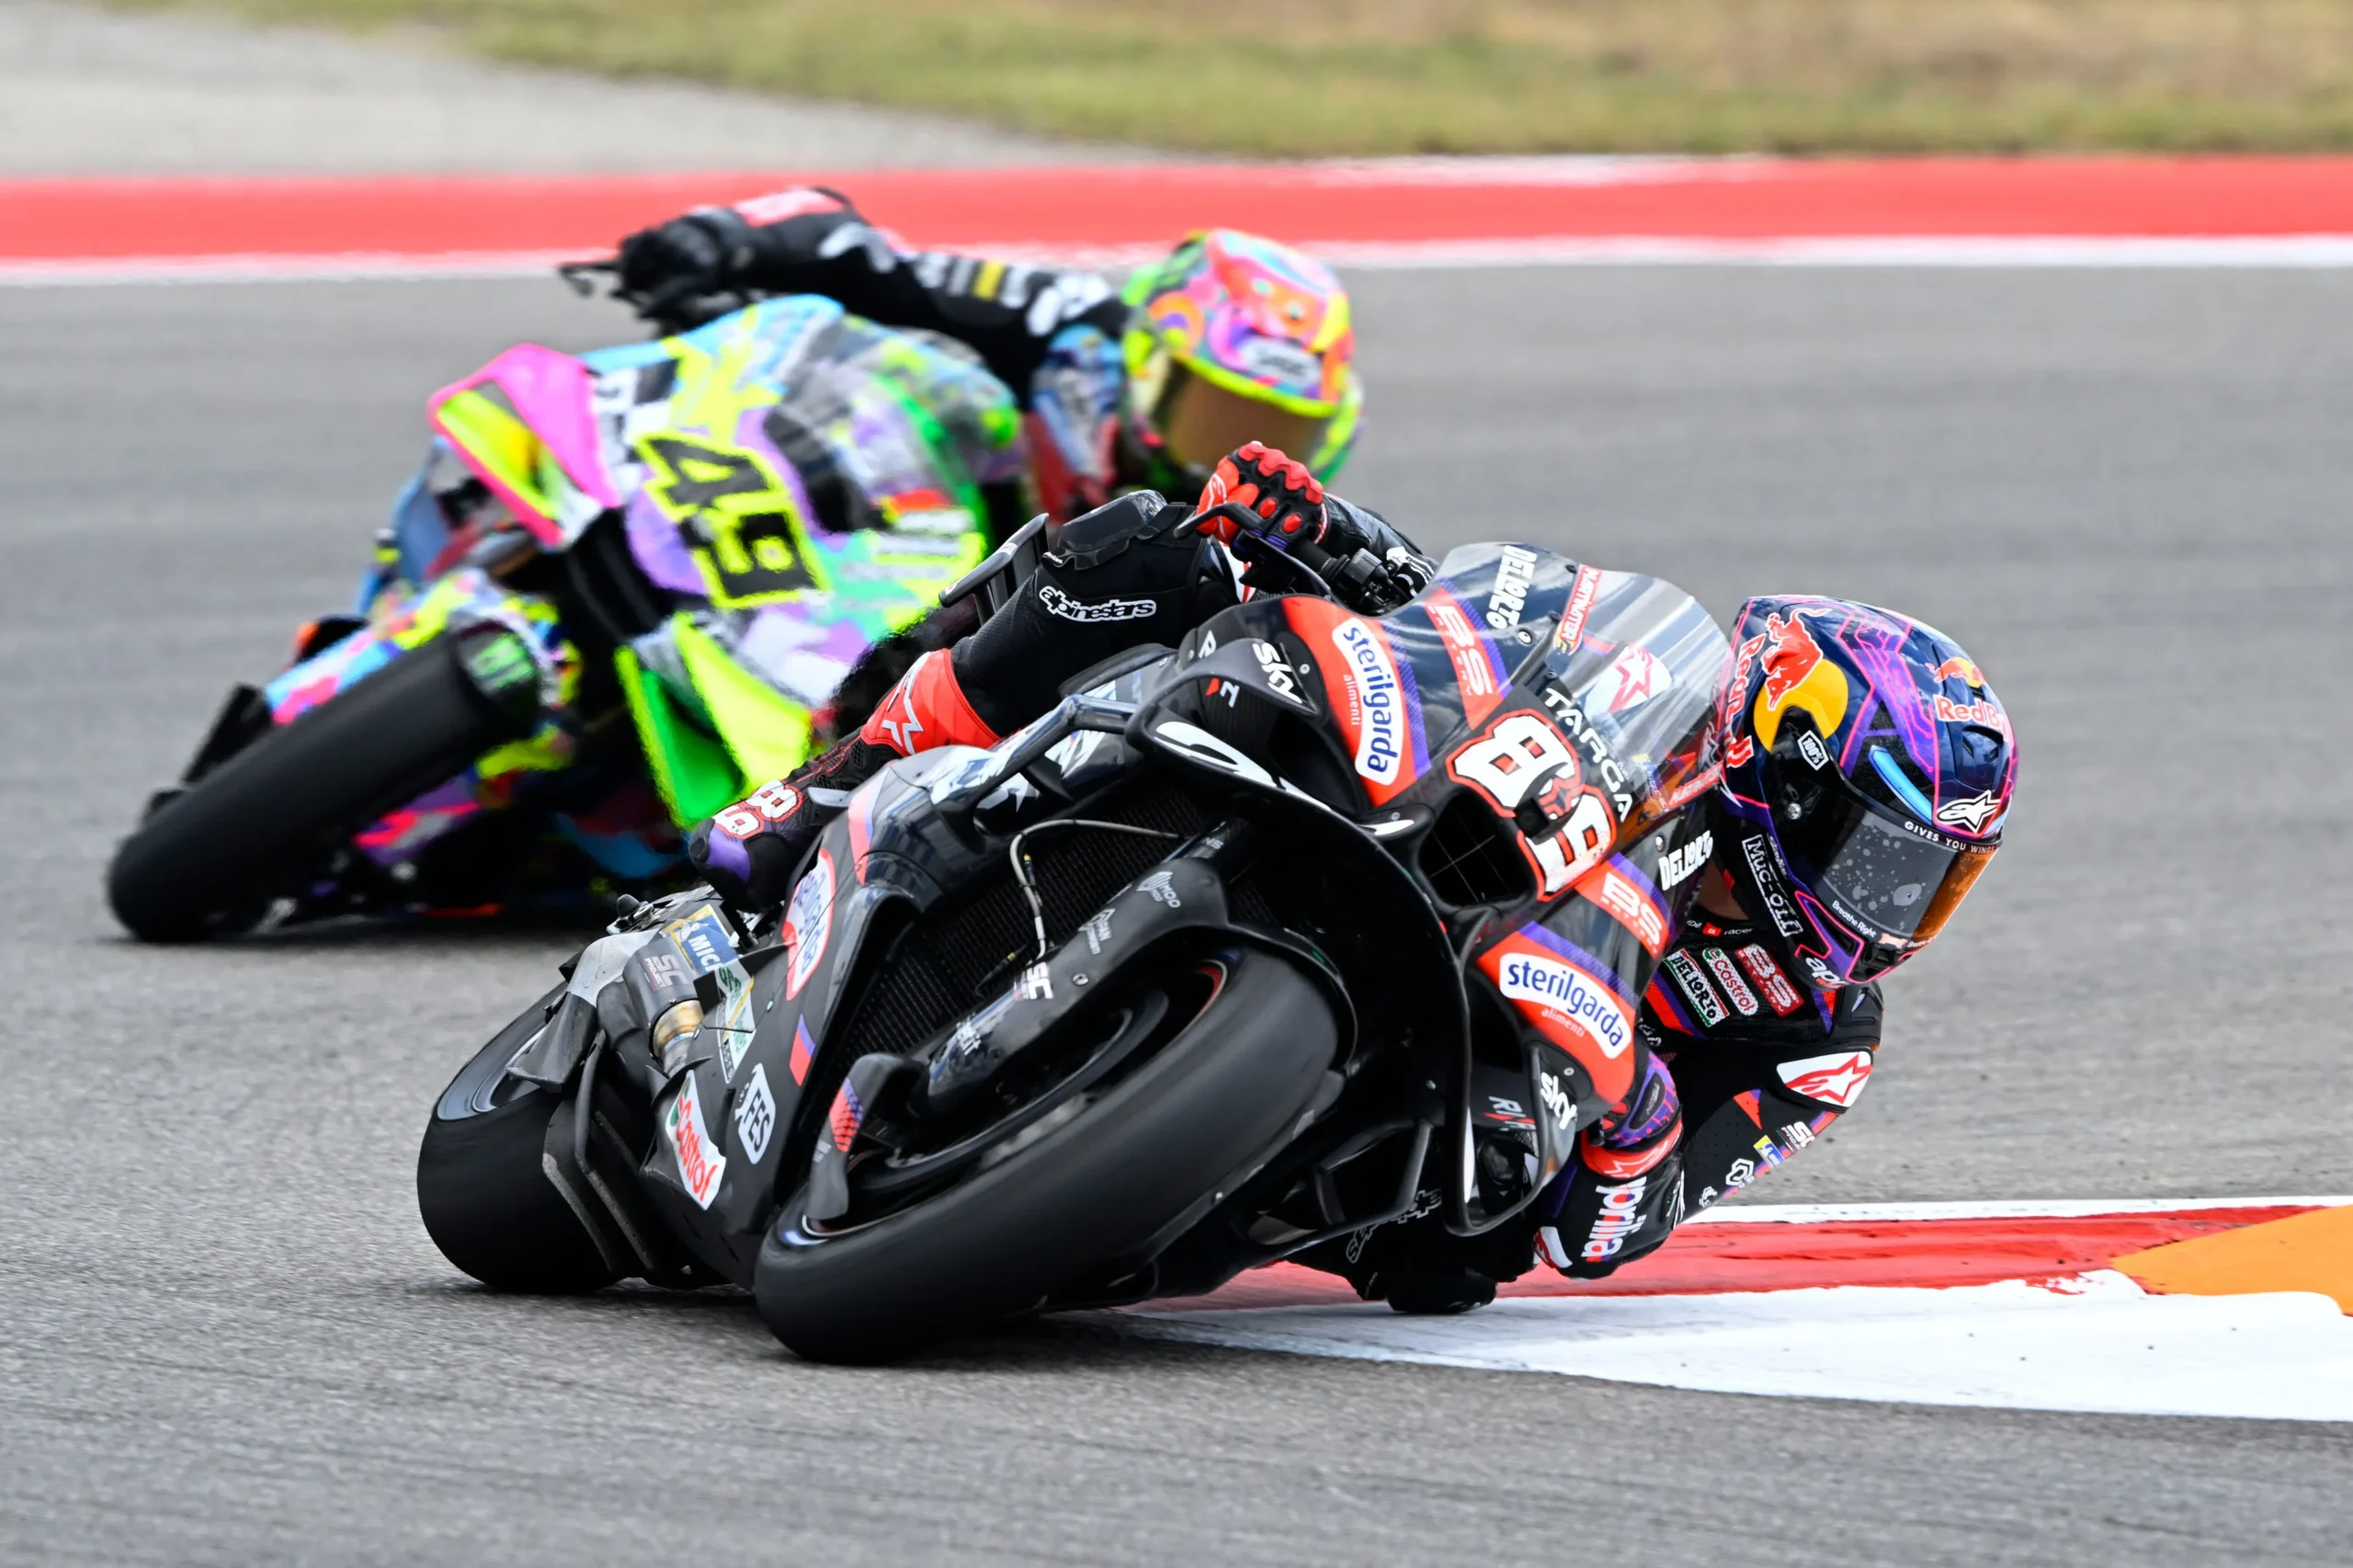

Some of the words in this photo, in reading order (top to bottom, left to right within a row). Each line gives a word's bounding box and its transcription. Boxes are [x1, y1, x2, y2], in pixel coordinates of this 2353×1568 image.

[639, 435, 823, 603] 49
[1040, 585, 1157, 622] alpinestars
[1485, 545, 1538, 629] DELLORTO
[1252, 642, 1303, 704] sky
[1435, 606, 1493, 696] BS
[1343, 674, 1362, 725] alimenti
[1343, 627, 1398, 773] sterilgarda
[1545, 687, 1633, 823] TARGA
[1802, 736, 1826, 765] 100%
[1449, 710, 1616, 898] 89
[1904, 821, 1939, 842] GIVES
[1946, 837, 1966, 851] YOU
[1971, 845, 1995, 854] WINGS
[1603, 871, 1662, 945] BS
[1723, 927, 1754, 936] racer
[1832, 900, 1858, 926] Breathe
[1858, 921, 1877, 937] Right
[644, 958, 666, 988] PROJECT
[650, 954, 689, 986] SC
[1026, 962, 1053, 1000] SC
[1670, 956, 1717, 1018] DELLORTO
[1714, 960, 1756, 1012] Castrol
[1743, 943, 1798, 1007] BS
[1507, 961, 1623, 1046] sterilgarda
[1540, 1007, 1586, 1038] alimenti
[1540, 1072, 1578, 1131] sky
[676, 1096, 719, 1203] Castrol
